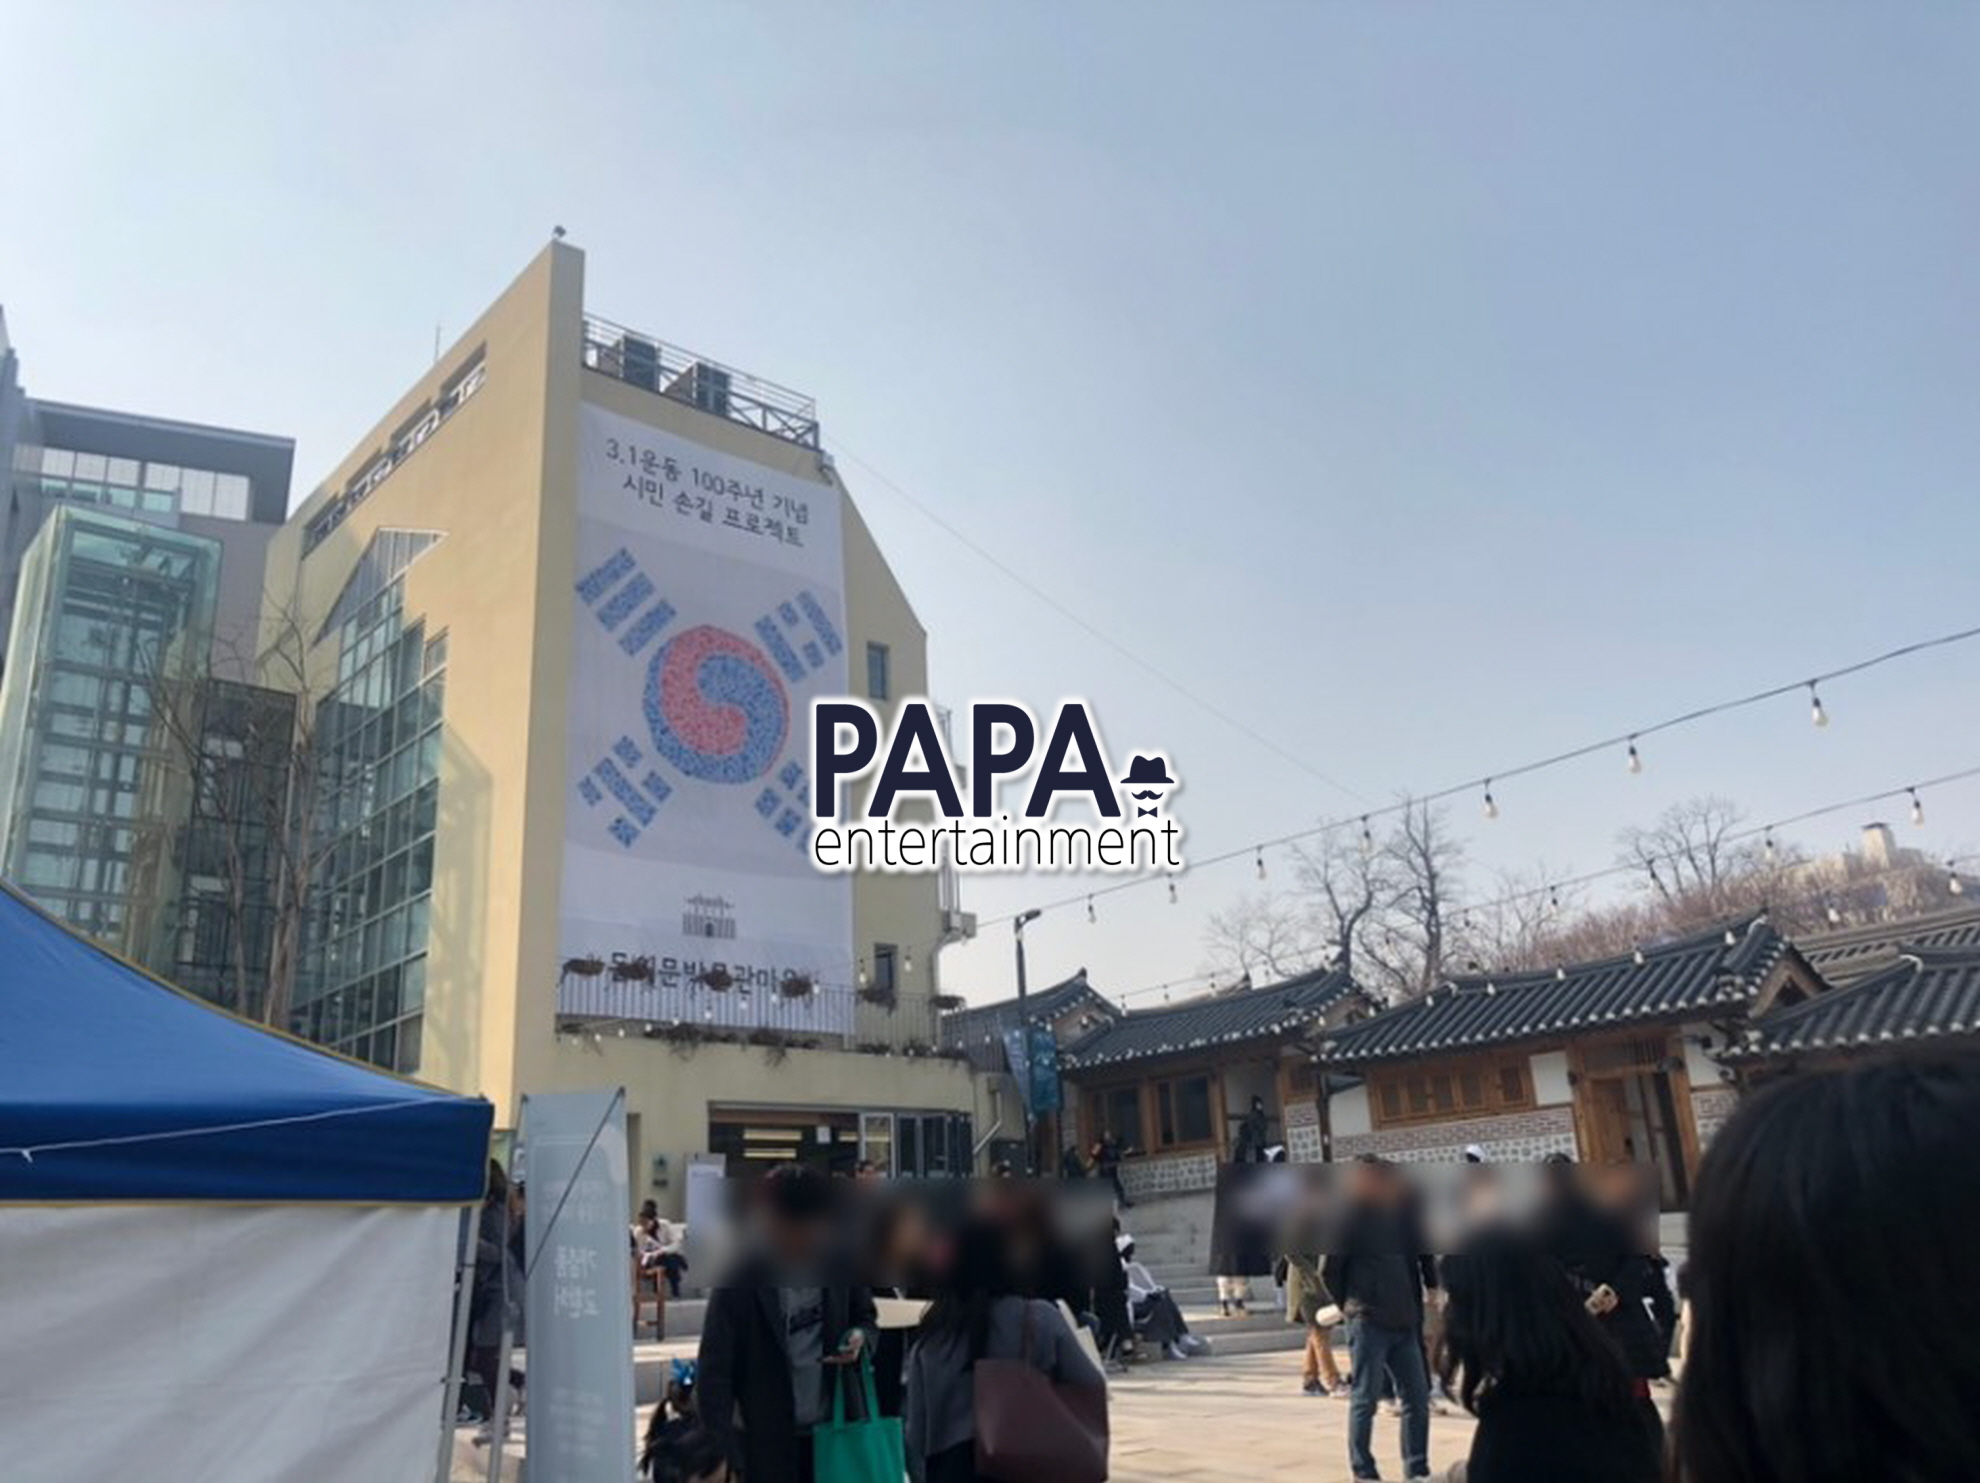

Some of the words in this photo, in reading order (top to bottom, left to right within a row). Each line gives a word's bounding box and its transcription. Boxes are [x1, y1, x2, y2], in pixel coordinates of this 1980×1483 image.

[606, 438, 682, 482] 3.1운동
[692, 467, 764, 509] 100주년
[773, 494, 809, 525] 기념
[623, 474, 664, 508] 시민
[674, 491, 714, 524] 손길
[722, 508, 805, 547] 프로젝트
[607, 951, 804, 996] 돈문박관마
